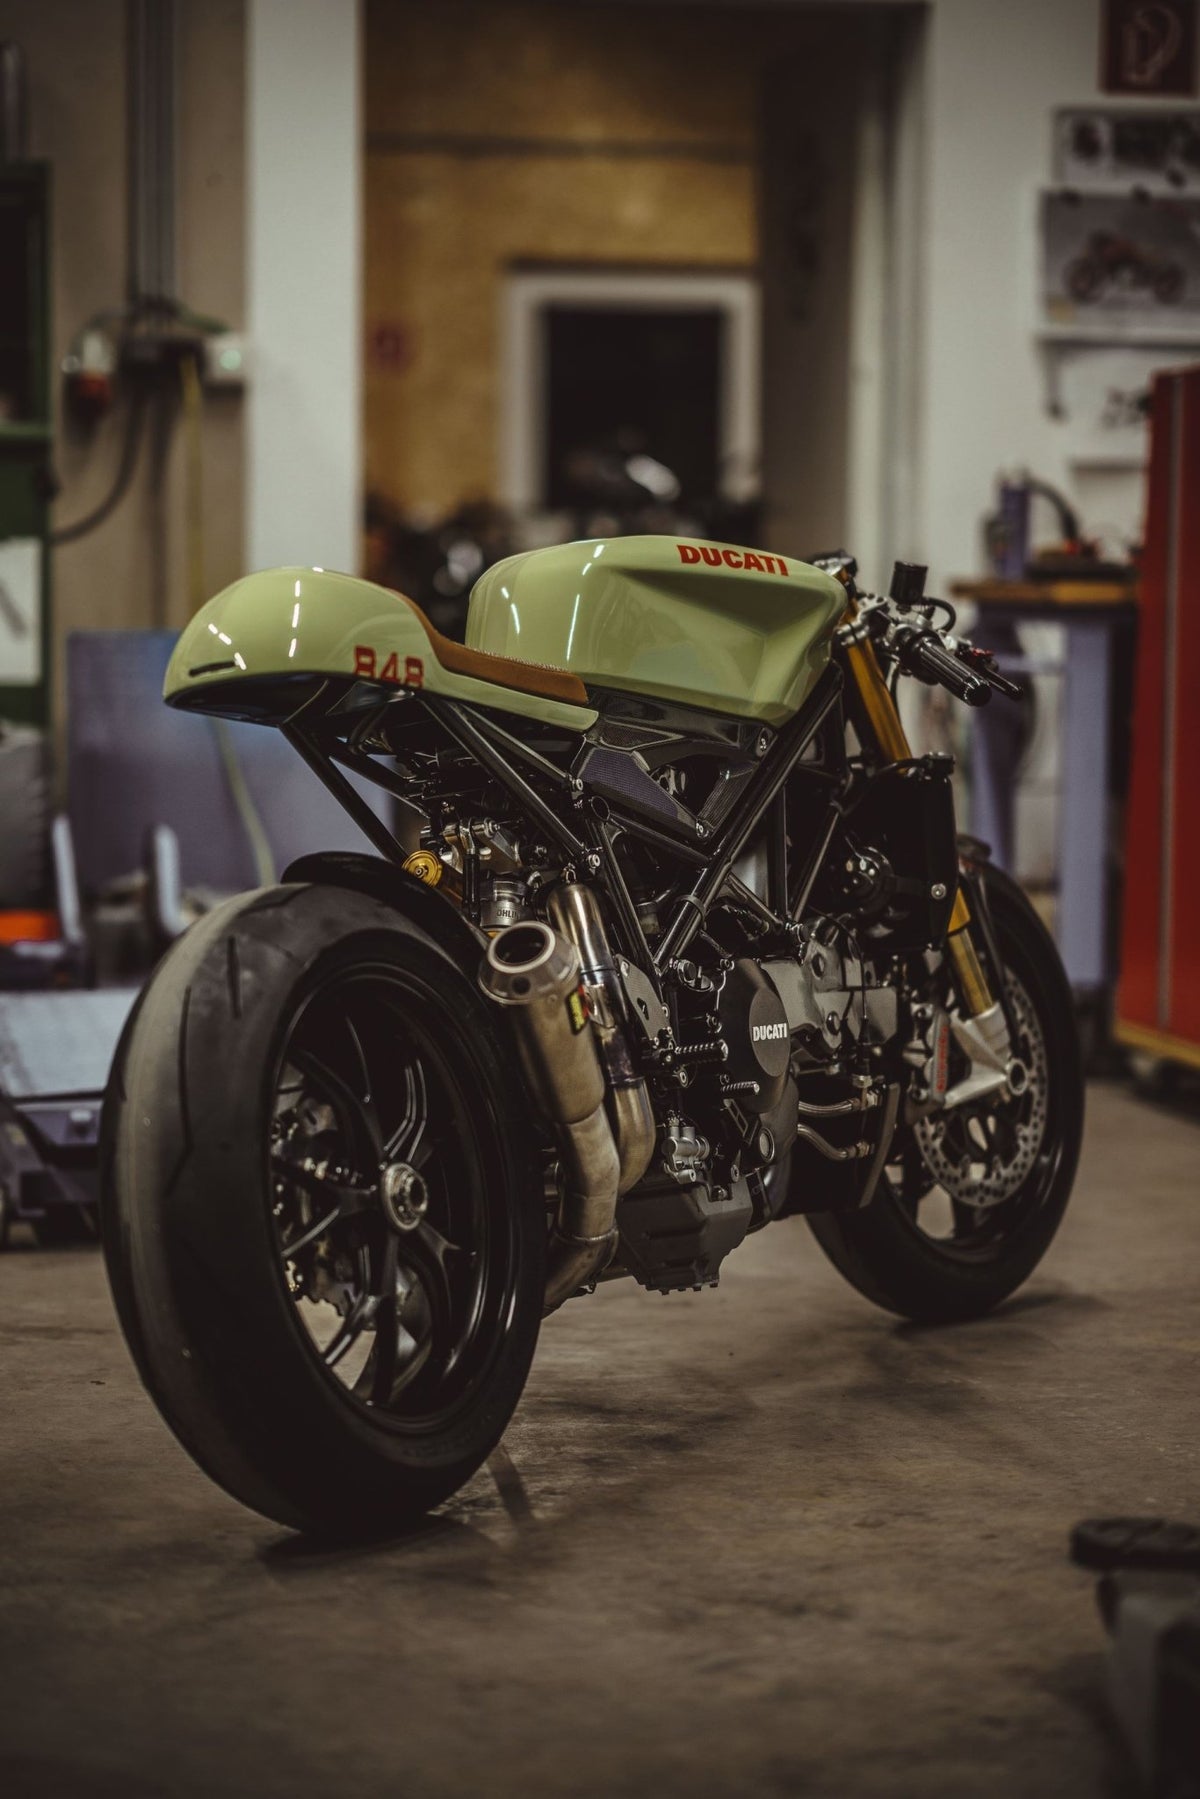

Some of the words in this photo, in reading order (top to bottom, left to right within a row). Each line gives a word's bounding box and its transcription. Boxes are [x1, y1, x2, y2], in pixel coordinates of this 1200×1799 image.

[677, 545, 789, 577] DUCATI
[355, 646, 424, 690] 848
[752, 1022, 788, 1042] DUCATI
